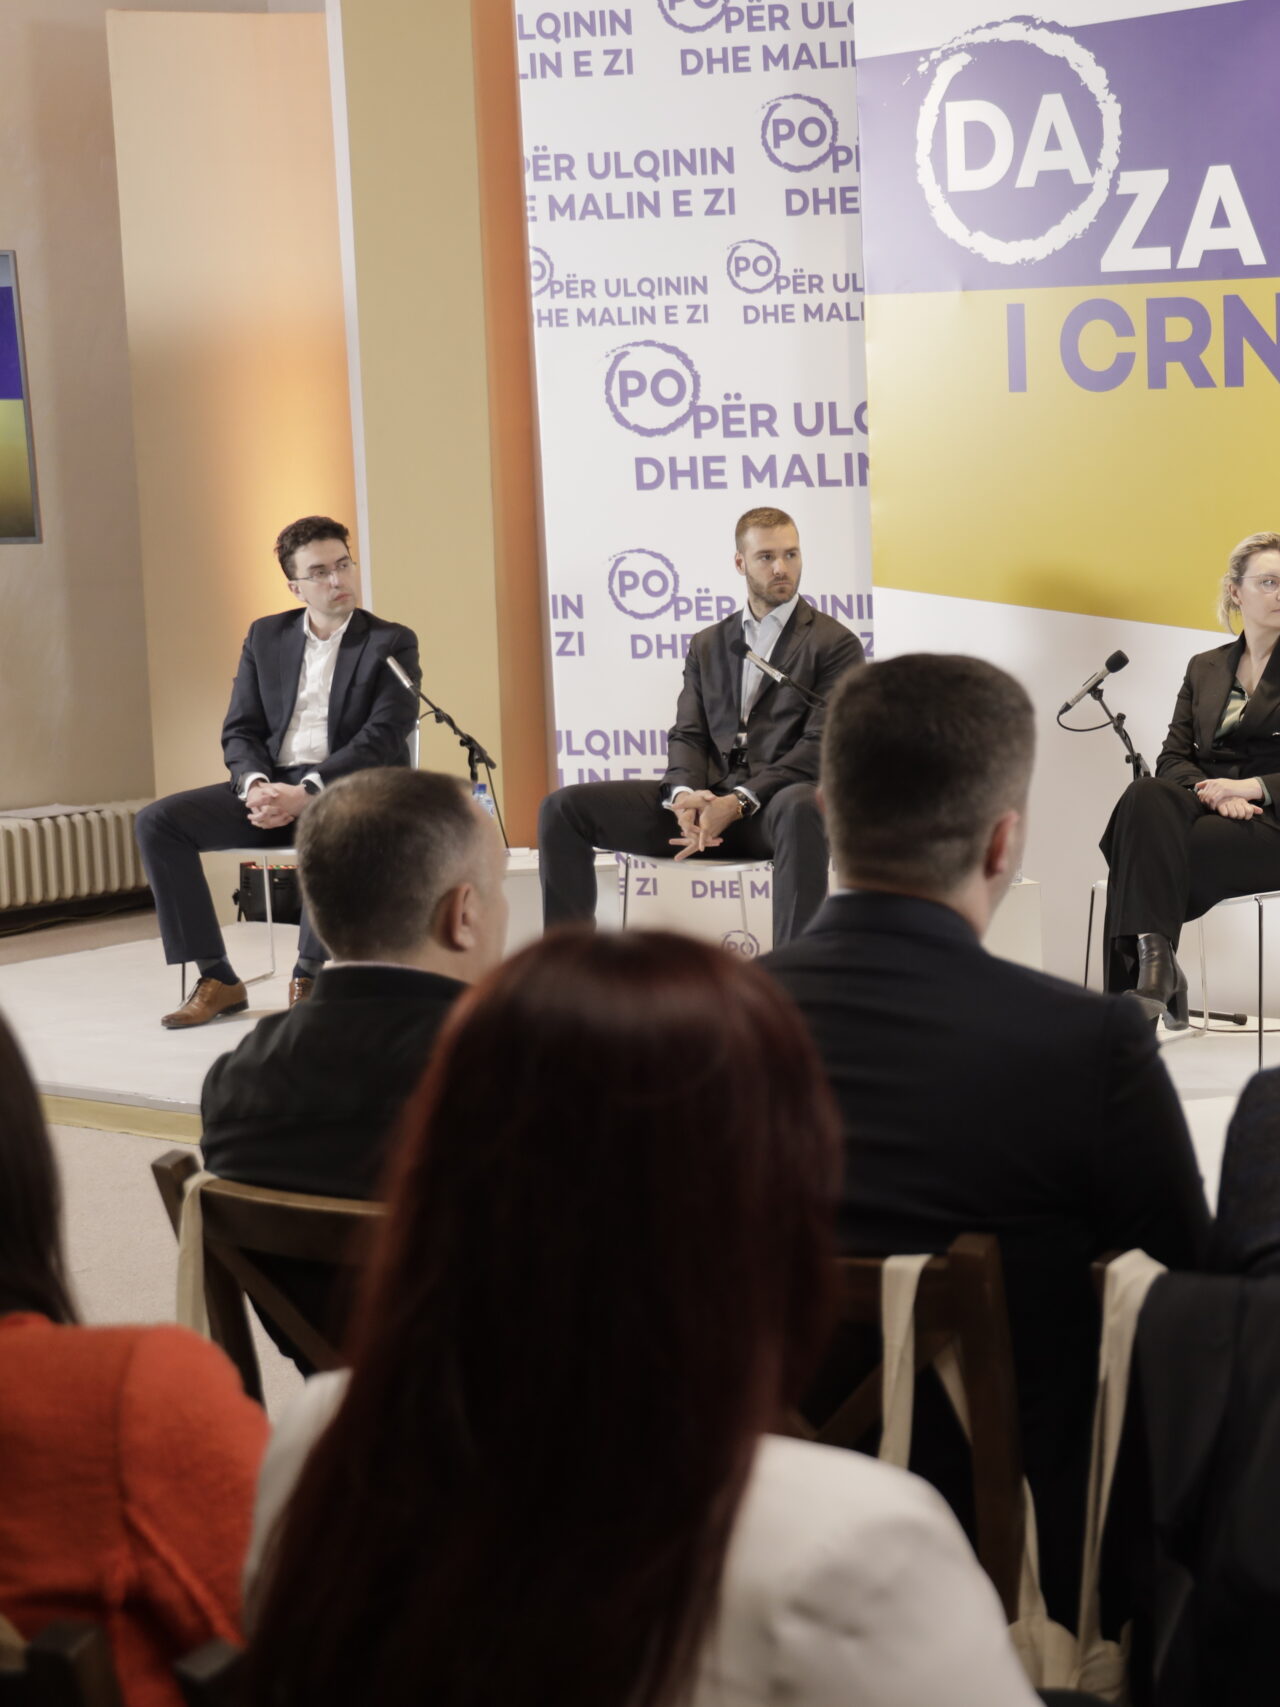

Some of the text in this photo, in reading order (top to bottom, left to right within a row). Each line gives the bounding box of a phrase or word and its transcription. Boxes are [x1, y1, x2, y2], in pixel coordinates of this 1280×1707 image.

[519, 48, 633, 79] IN E ZI
[680, 40, 856, 76] DHE MALI
[772, 116, 827, 149] PO
[945, 93, 1095, 193] DA
[524, 145, 735, 183] ËR ULQININ
[548, 190, 661, 222] MALIN
[672, 189, 694, 217] E
[703, 187, 736, 216] ZI
[785, 186, 860, 217] DHE
[1100, 164, 1267, 273] ZA
[734, 255, 773, 278] PO
[775, 268, 825, 295] PËR
[550, 273, 708, 300] PËR ULQININ
[576, 305, 656, 328] MALIN
[664, 304, 679, 325] E
[686, 303, 709, 324] ZI
[743, 303, 795, 325] DHE
[1006, 303, 1027, 393] I
[619, 368, 687, 407] PO
[693, 392, 779, 439] PËR
[635, 456, 728, 491] DHE
[618, 569, 669, 598] PO
[673, 587, 737, 621] PËR
[555, 631, 585, 657] ZI
[636, 877, 657, 896] ZI
[691, 879, 741, 899] DHE
